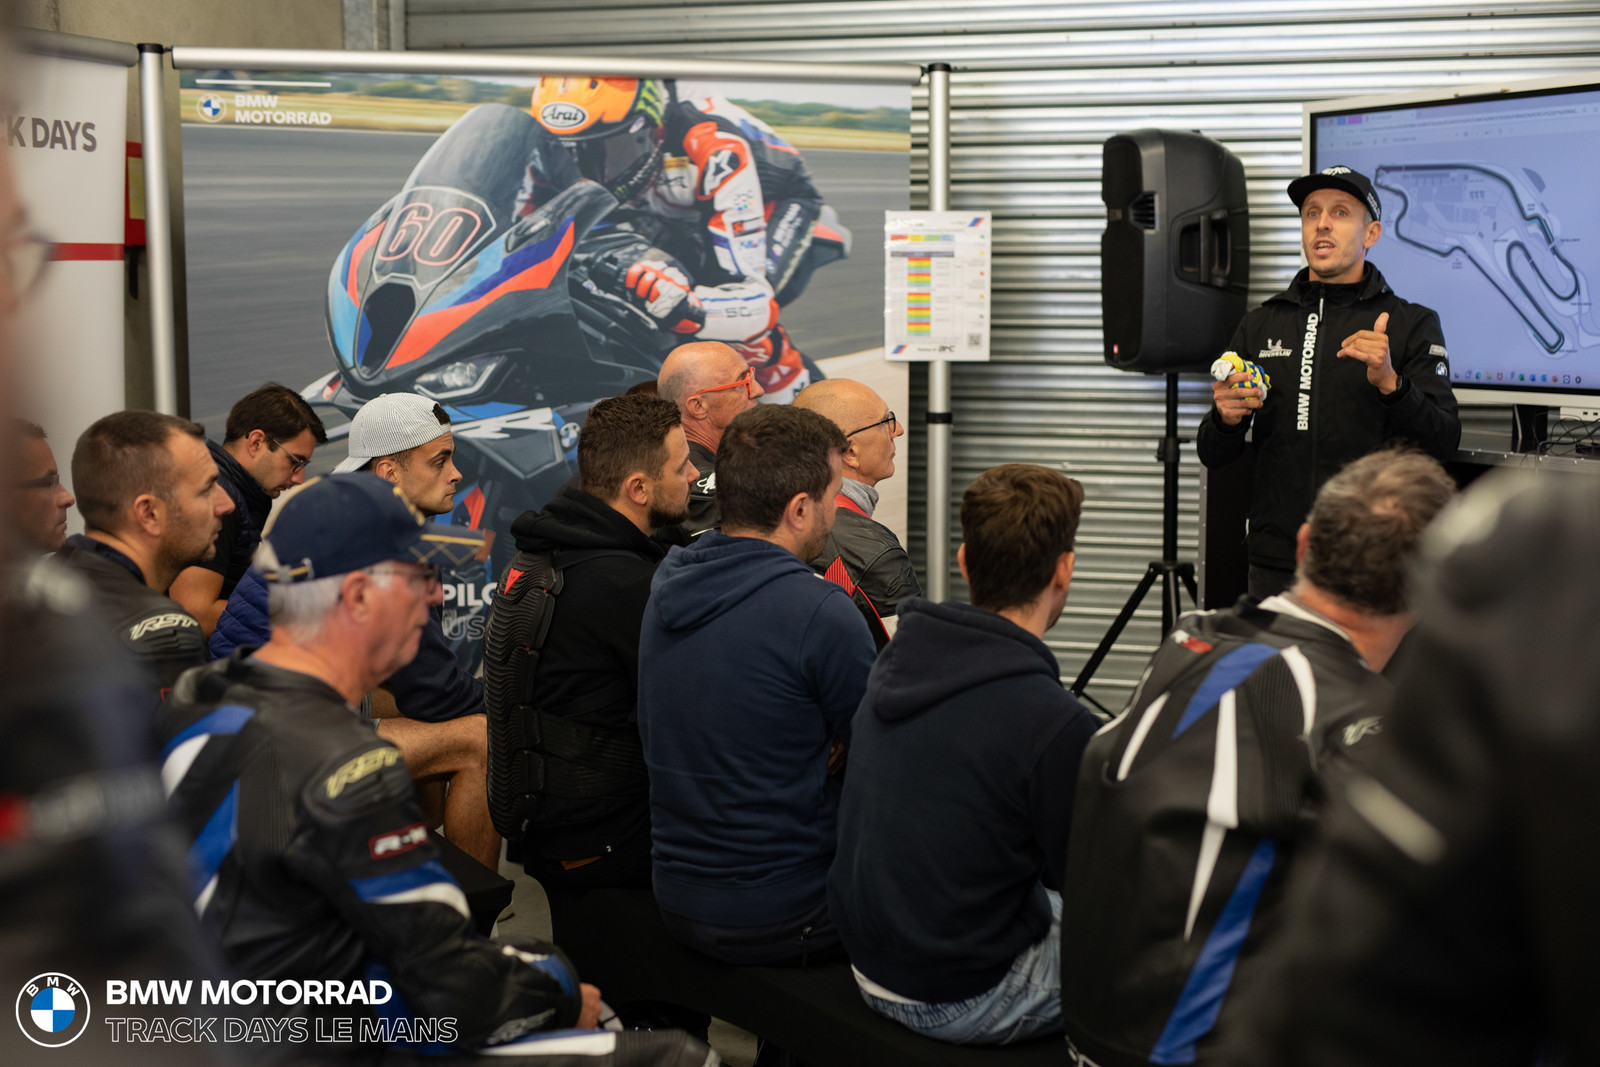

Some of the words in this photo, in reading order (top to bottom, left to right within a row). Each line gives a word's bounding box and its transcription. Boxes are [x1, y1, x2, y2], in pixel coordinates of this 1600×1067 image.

[234, 94, 279, 108] BMW
[234, 110, 332, 125] MOTORRAD
[543, 104, 580, 121] Arai
[31, 117, 97, 152] DAYS
[378, 202, 481, 266] 60
[1299, 312, 1319, 390] MOTORRAD
[1297, 392, 1310, 430] BMW
